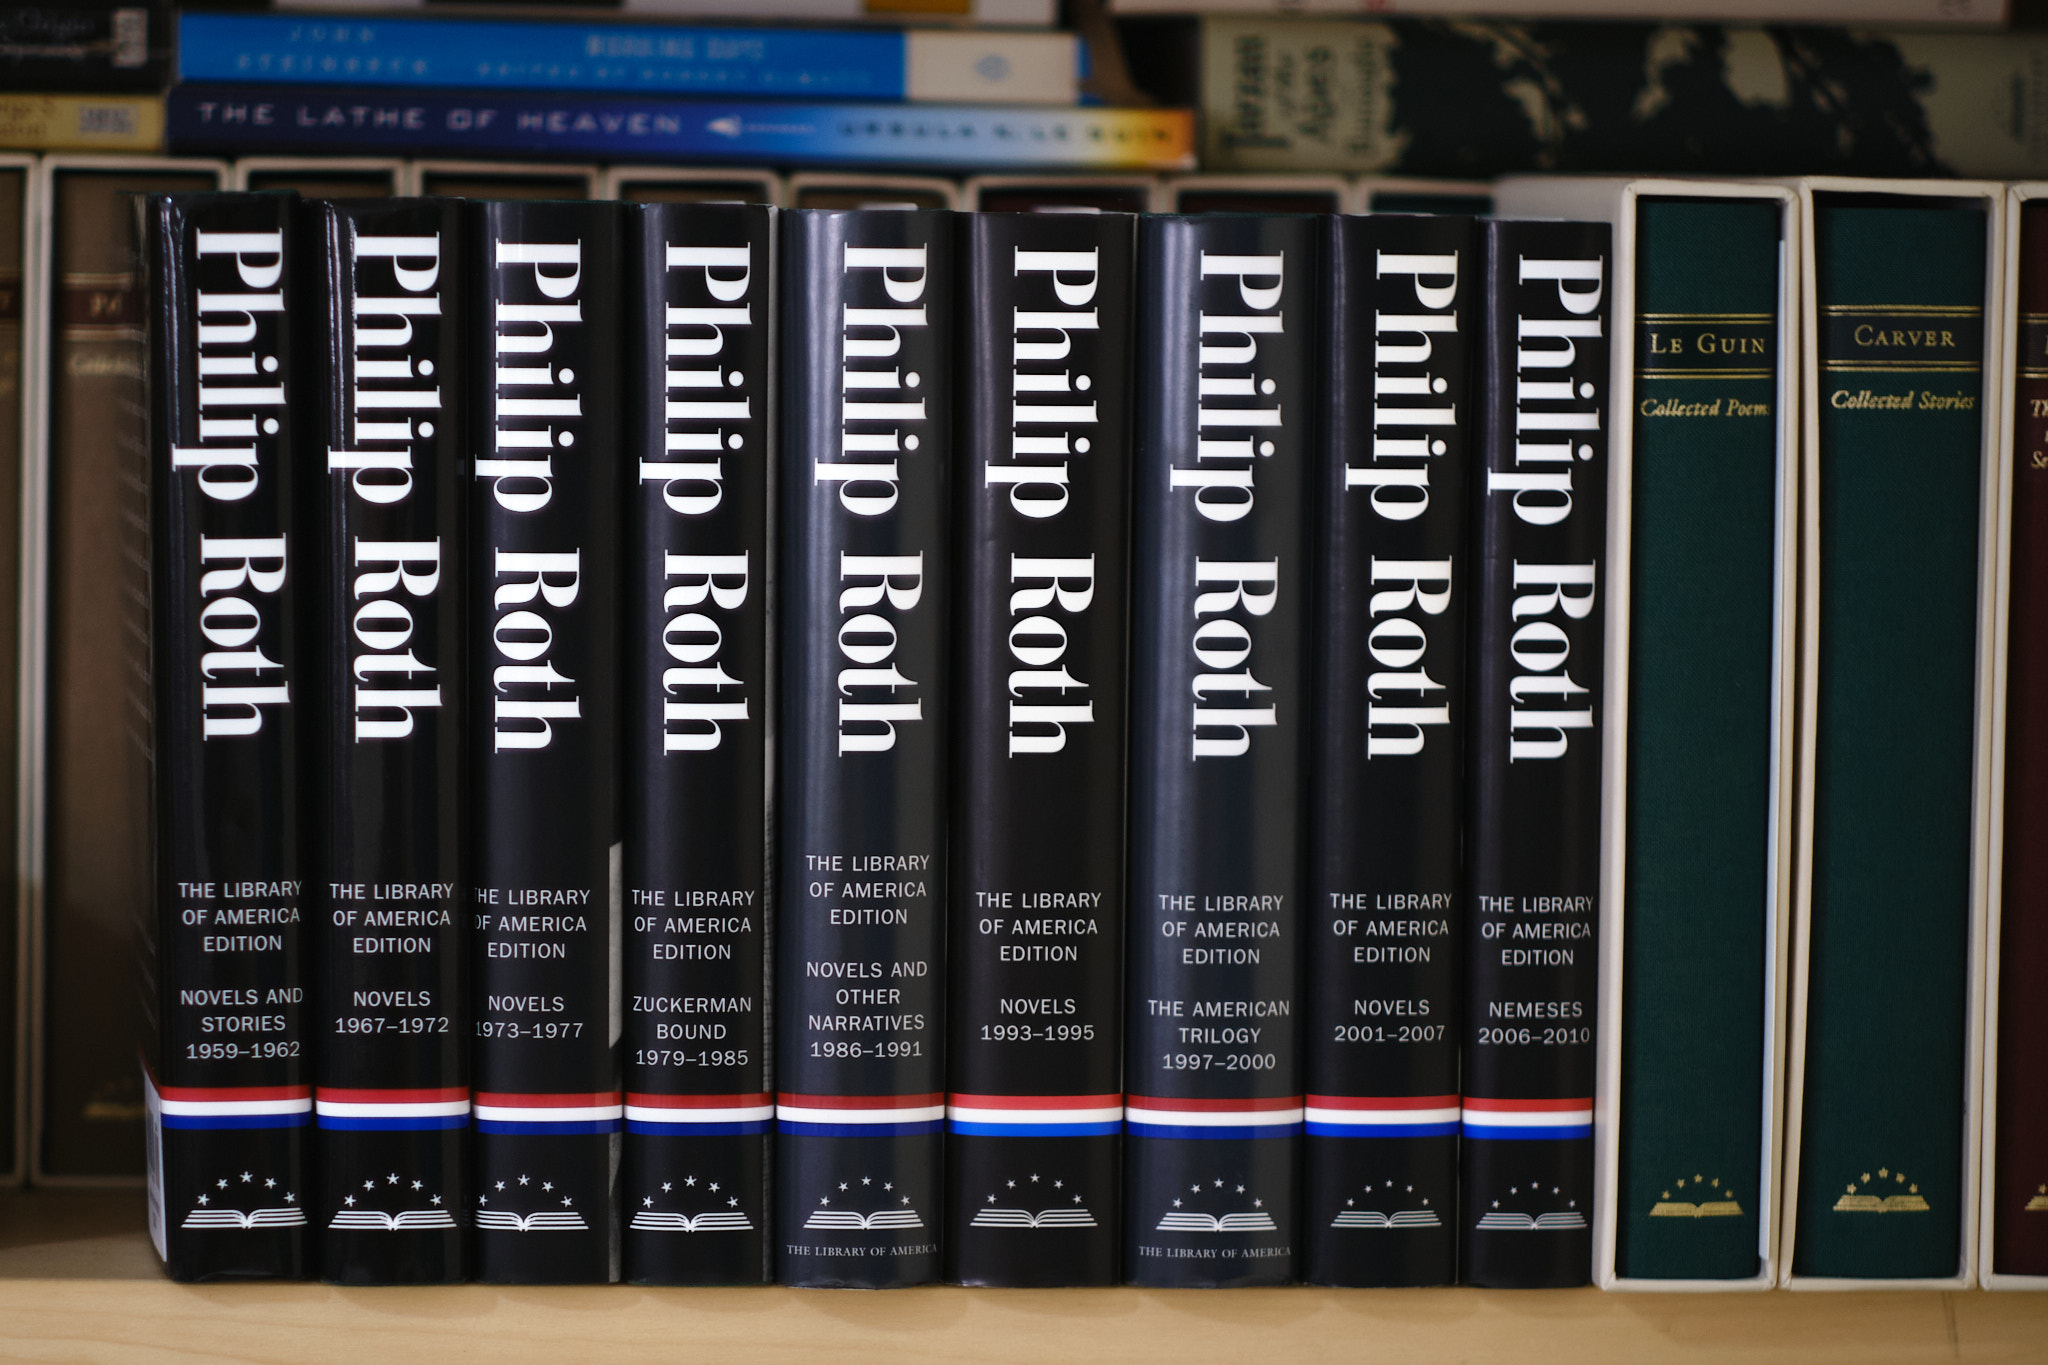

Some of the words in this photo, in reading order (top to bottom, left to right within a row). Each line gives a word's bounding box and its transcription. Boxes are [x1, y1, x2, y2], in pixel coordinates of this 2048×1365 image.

[200, 103, 271, 125] THE
[298, 107, 424, 130] LATHE
[447, 109, 495, 130] OF
[516, 111, 682, 134] HEAVEN
[172, 228, 287, 500] Philip
[328, 231, 442, 503] Philip
[475, 238, 582, 512] Philip
[639, 241, 752, 514] Philip
[815, 243, 927, 516] Philip
[985, 246, 1099, 518] Philip
[1170, 250, 1283, 521] Philip
[1345, 250, 1458, 520] Philip
[1488, 254, 1604, 525] Philip
[1641, 399, 1720, 416] Collected
[1725, 398, 1769, 416] Poem
[1831, 390, 1914, 409] Collected
[1919, 391, 1974, 409] Stories
[200, 533, 290, 741] Roth
[353, 536, 442, 743] Roth
[494, 547, 581, 753] Roth
[663, 549, 749, 756] Roth
[838, 550, 923, 757] Roth
[1009, 553, 1094, 758] Roth
[1367, 555, 1452, 759] Roth
[1192, 556, 1278, 761] Roth
[1510, 559, 1595, 763] Roth
[806, 855, 842, 871] THE
[853, 855, 929, 871] LIBRARY
[178, 883, 215, 898] THE
[225, 881, 302, 897] LIBRARY
[330, 884, 365, 899] THE
[375, 884, 453, 899] LIBRARY
[475, 887, 499, 904] HE
[509, 890, 590, 905] LIBRARY
[810, 882, 834, 897] OF
[842, 882, 926, 898] AMERICA
[632, 890, 665, 906] THE
[675, 891, 754, 906] LIBRARY
[976, 892, 1012, 908] THE
[1023, 893, 1101, 908] LIBRARY
[1159, 895, 1195, 910] THE
[1206, 896, 1283, 911] LIBRARY
[1330, 893, 1366, 909] THE
[1377, 894, 1451, 909] LIBRARY
[1479, 896, 1513, 912] THE
[1523, 897, 1591, 912] LIBRARY
[183, 910, 207, 925] OF
[215, 908, 301, 924] AMERICA
[333, 911, 357, 926] OF
[364, 911, 450, 926] AMERICA
[499, 916, 586, 931] AMERICA
[831, 909, 907, 924] EDITION
[635, 917, 657, 932] OF
[665, 918, 751, 933] AMERICA
[980, 919, 1004, 934] OF
[1012, 919, 1097, 934] AMERICA
[1162, 921, 1186, 937] OF
[1195, 922, 1279, 937] AMERICA
[1333, 920, 1358, 935] OF
[1366, 920, 1448, 936] AMERICA
[1482, 922, 1505, 938] OF
[1513, 923, 1590, 938] AMERICA
[204, 936, 281, 951] EDITION
[354, 938, 430, 953] EDITION
[488, 942, 564, 958] EDITION
[654, 944, 730, 959] EDITION
[1001, 946, 1076, 961] EDITION
[1183, 948, 1259, 964] EDITION
[1354, 947, 1430, 962] EDITION
[1502, 950, 1573, 965] EDITION
[807, 962, 882, 977] NOVELS
[891, 961, 927, 977] AND
[181, 989, 258, 1005] NOVELS
[266, 988, 303, 1004] AND
[354, 991, 430, 1006] NOVELS
[489, 996, 564, 1011] NOVELS
[633, 996, 751, 1012] ZUCKERMAN
[836, 989, 900, 1004] OTHER
[1001, 999, 1075, 1014] NOVELS
[1148, 1000, 1183, 1016] THE
[1193, 1001, 1289, 1017] AMERICAN
[1355, 1000, 1429, 1015] NOVELS
[1490, 1002, 1582, 1018] NEMESES
[202, 1015, 285, 1032] STORIES
[809, 1014, 924, 1030] NARRATIVES
[657, 1024, 726, 1039] BOUND
[1179, 1028, 1260, 1043] TRILOGY
[788, 1245, 810, 1256] THE
[816, 1247, 865, 1257] LIBRARY
[870, 1246, 886, 1257] OF
[889, 1244, 937, 1257] AMERICA
[1139, 1247, 1162, 1257] THE
[1167, 1248, 1217, 1259] LIBRARY
[1222, 1249, 1236, 1259] OF
[1242, 1248, 1290, 1258] AMERICA
